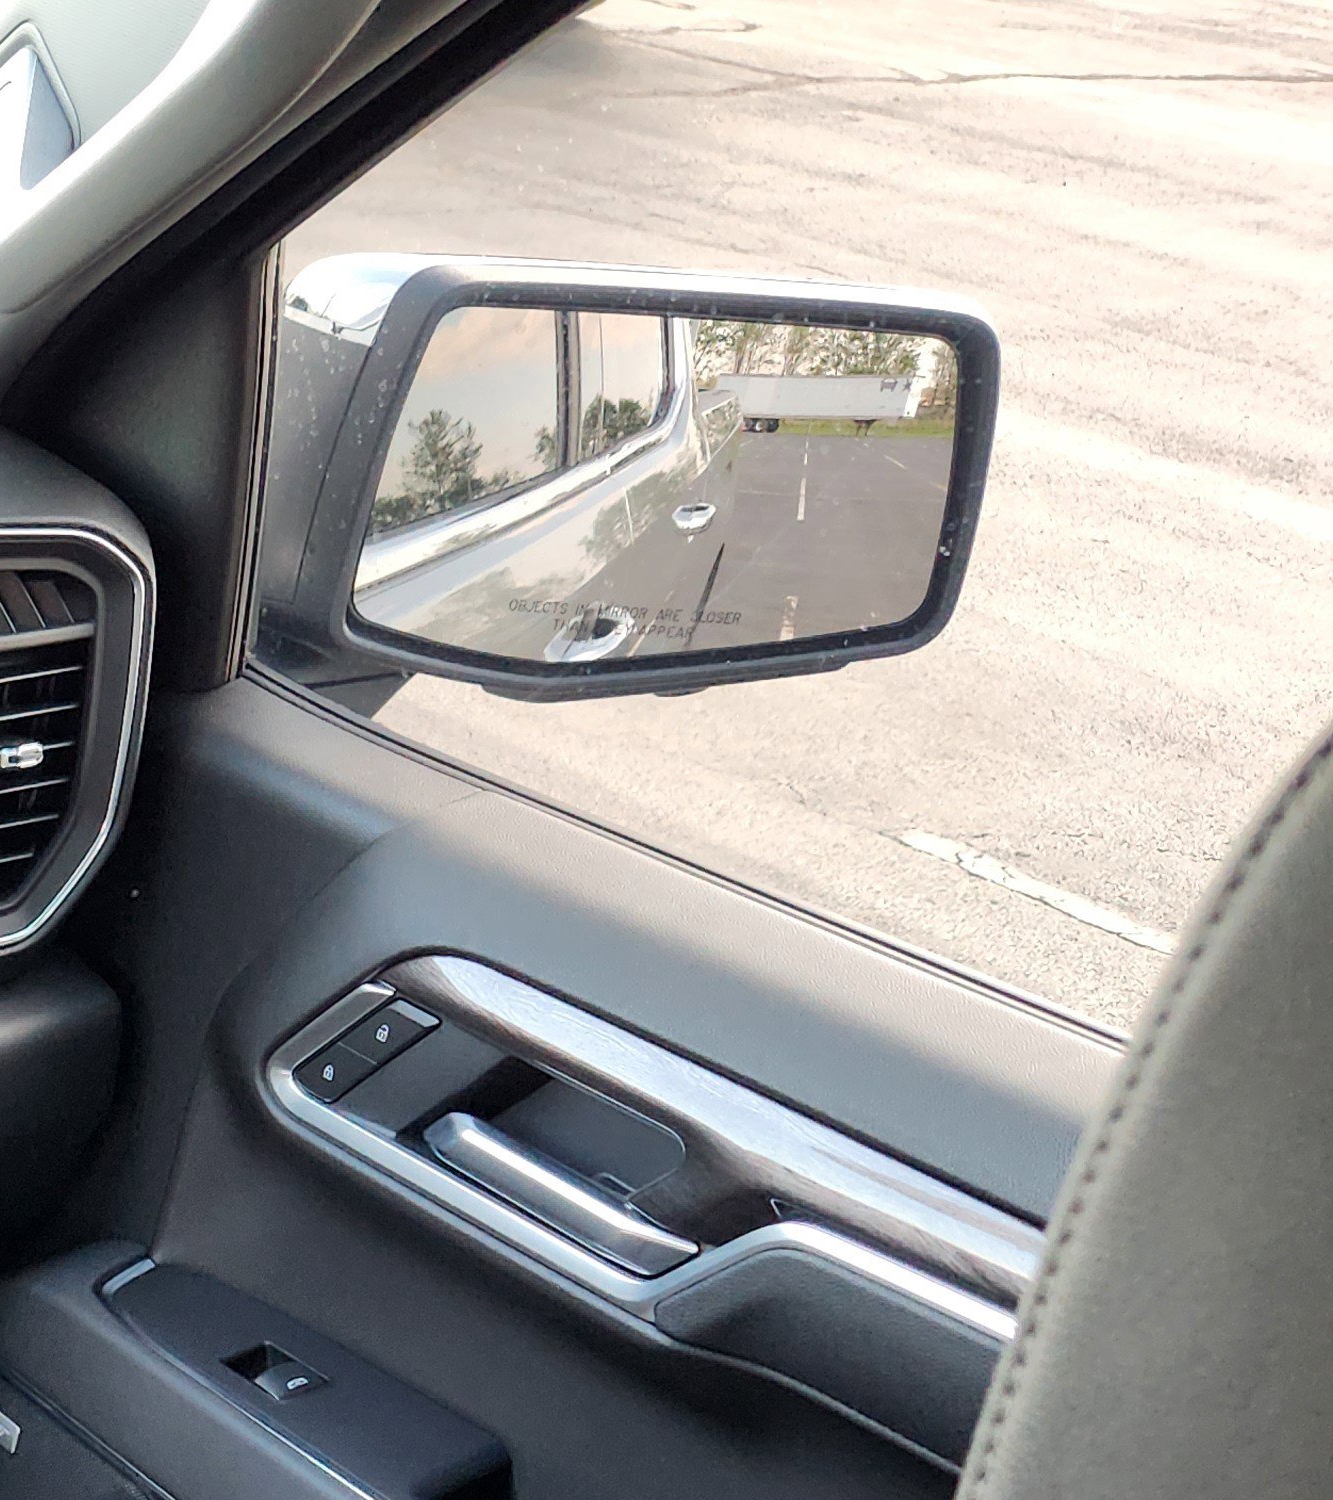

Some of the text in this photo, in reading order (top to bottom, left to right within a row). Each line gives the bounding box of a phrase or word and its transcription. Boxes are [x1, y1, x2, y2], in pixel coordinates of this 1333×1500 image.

[508, 598, 568, 615] OBJECTS
[654, 609, 681, 622] ARE
[639, 624, 694, 640] APPEAR
